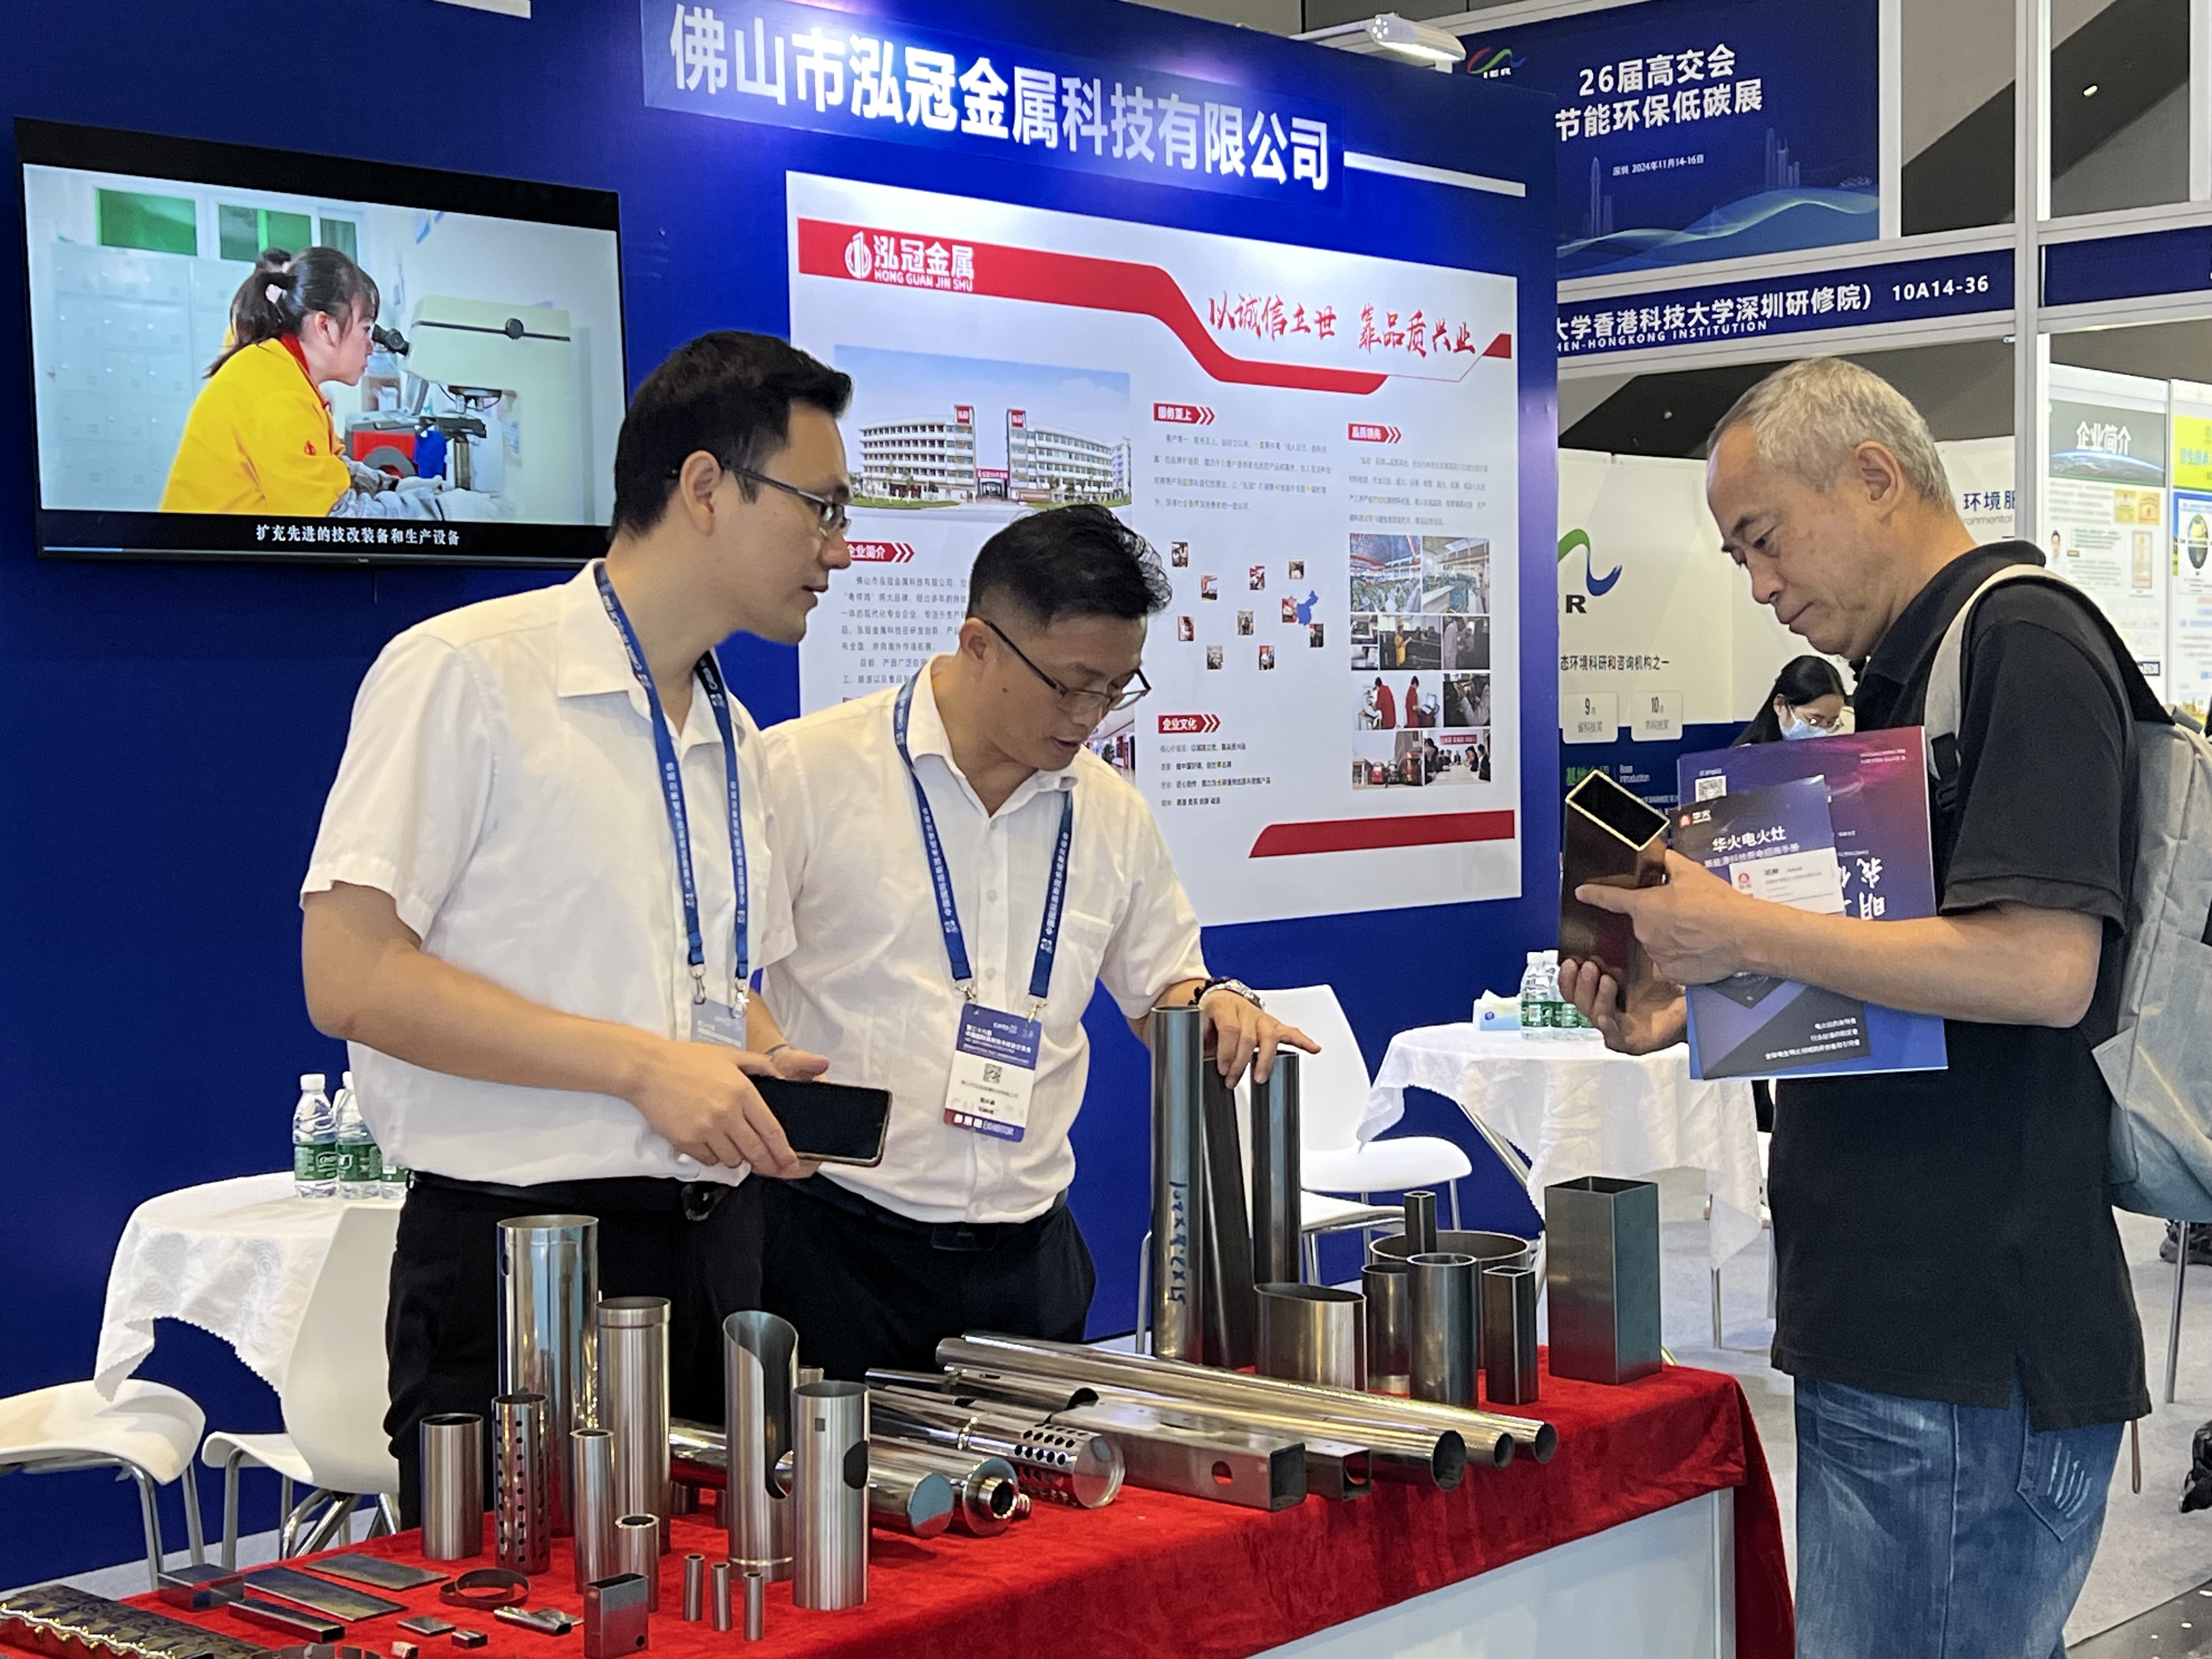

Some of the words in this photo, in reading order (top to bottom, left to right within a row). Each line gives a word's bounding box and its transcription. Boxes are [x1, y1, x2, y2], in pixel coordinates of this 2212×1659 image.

[1579, 43, 1736, 97] 26届高交会
[670, 3, 1330, 191] 佛山市泓冠金属科技有限公司
[1555, 78, 1763, 142] 节能环保低碳展
[873, 234, 974, 279] 泓冠金属
[873, 268, 904, 284] HONG
[906, 272, 934, 287] GUAN
[935, 276, 951, 290] JIN
[953, 278, 973, 292] SHU
[1892, 275, 1989, 301] 10A14-36
[1673, 320, 1767, 340] INSTITUTION
[2076, 421, 2131, 456] 企业简介
[256, 523, 461, 546] 扩充先进的技改装备和生产设备
[1565, 594, 1587, 614] R
[1162, 717, 1197, 731] 企业文化
[1712, 825, 1786, 853] 华火电火灶
